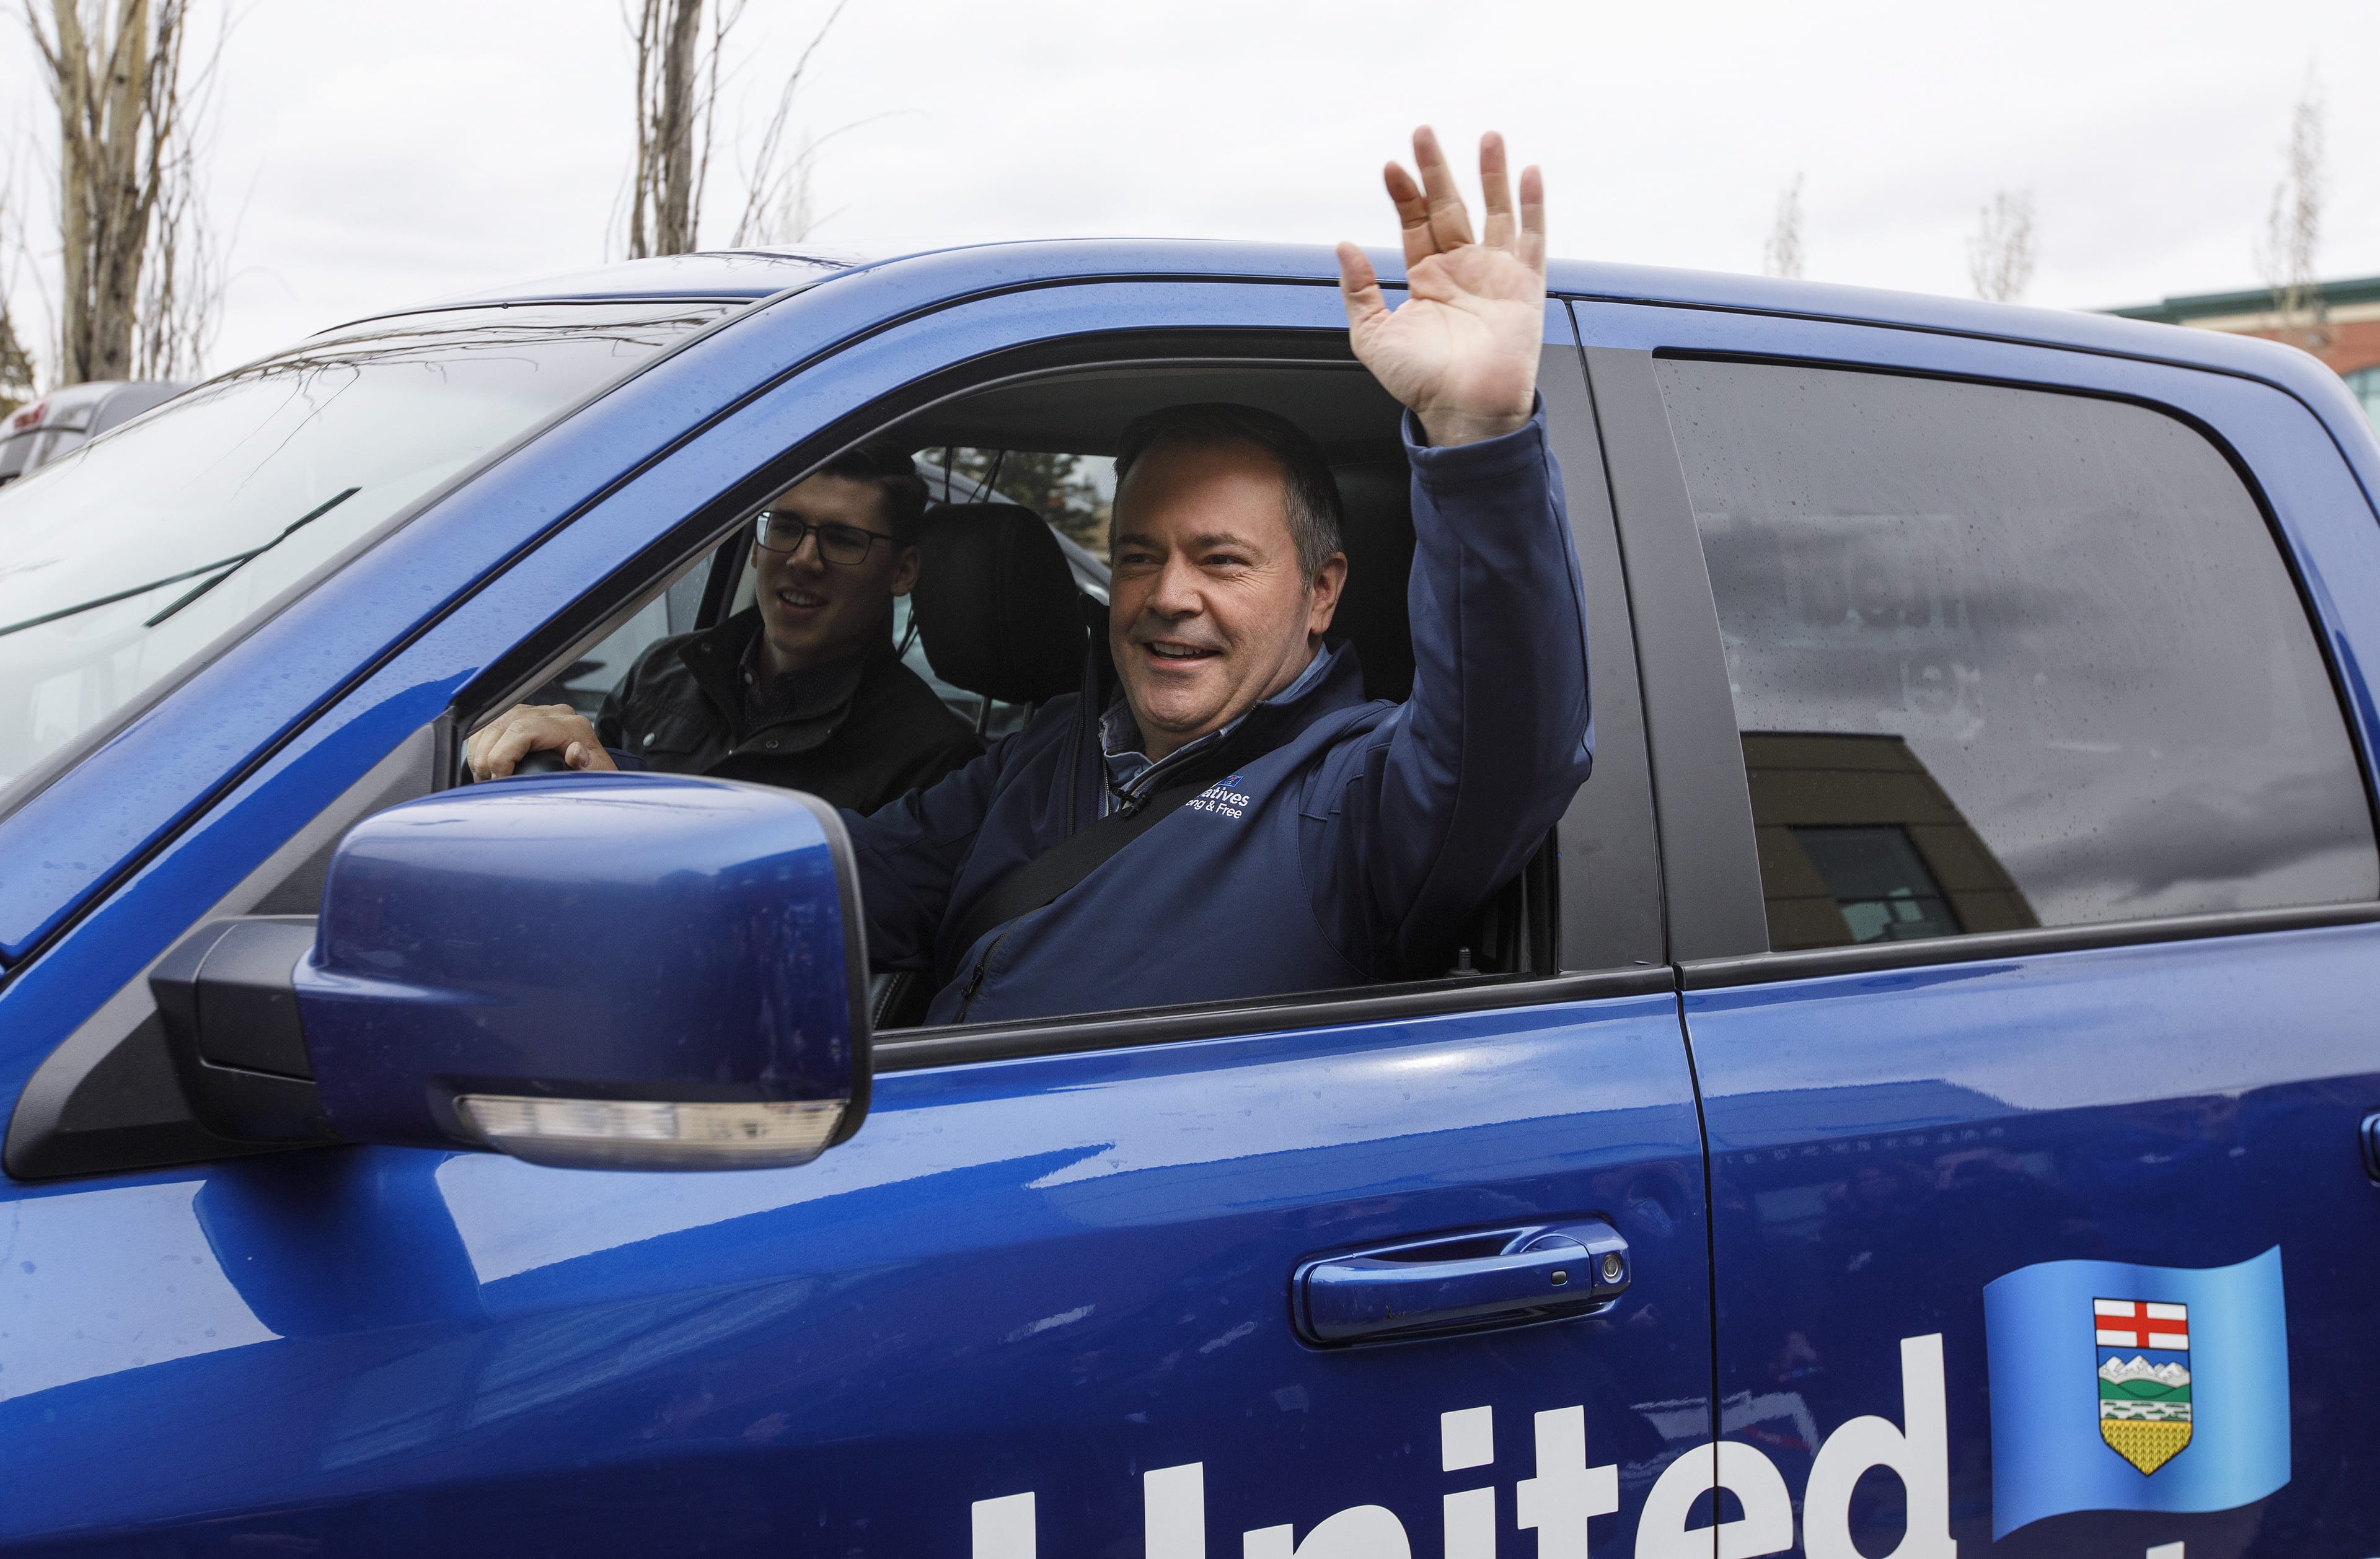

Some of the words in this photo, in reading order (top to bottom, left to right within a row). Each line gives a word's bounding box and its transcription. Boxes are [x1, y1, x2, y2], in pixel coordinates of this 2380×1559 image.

[1197, 786, 1250, 806] atives
[1205, 799, 1215, 812] &
[1215, 802, 1242, 819] Free
[971, 1333, 1957, 1559] ited
